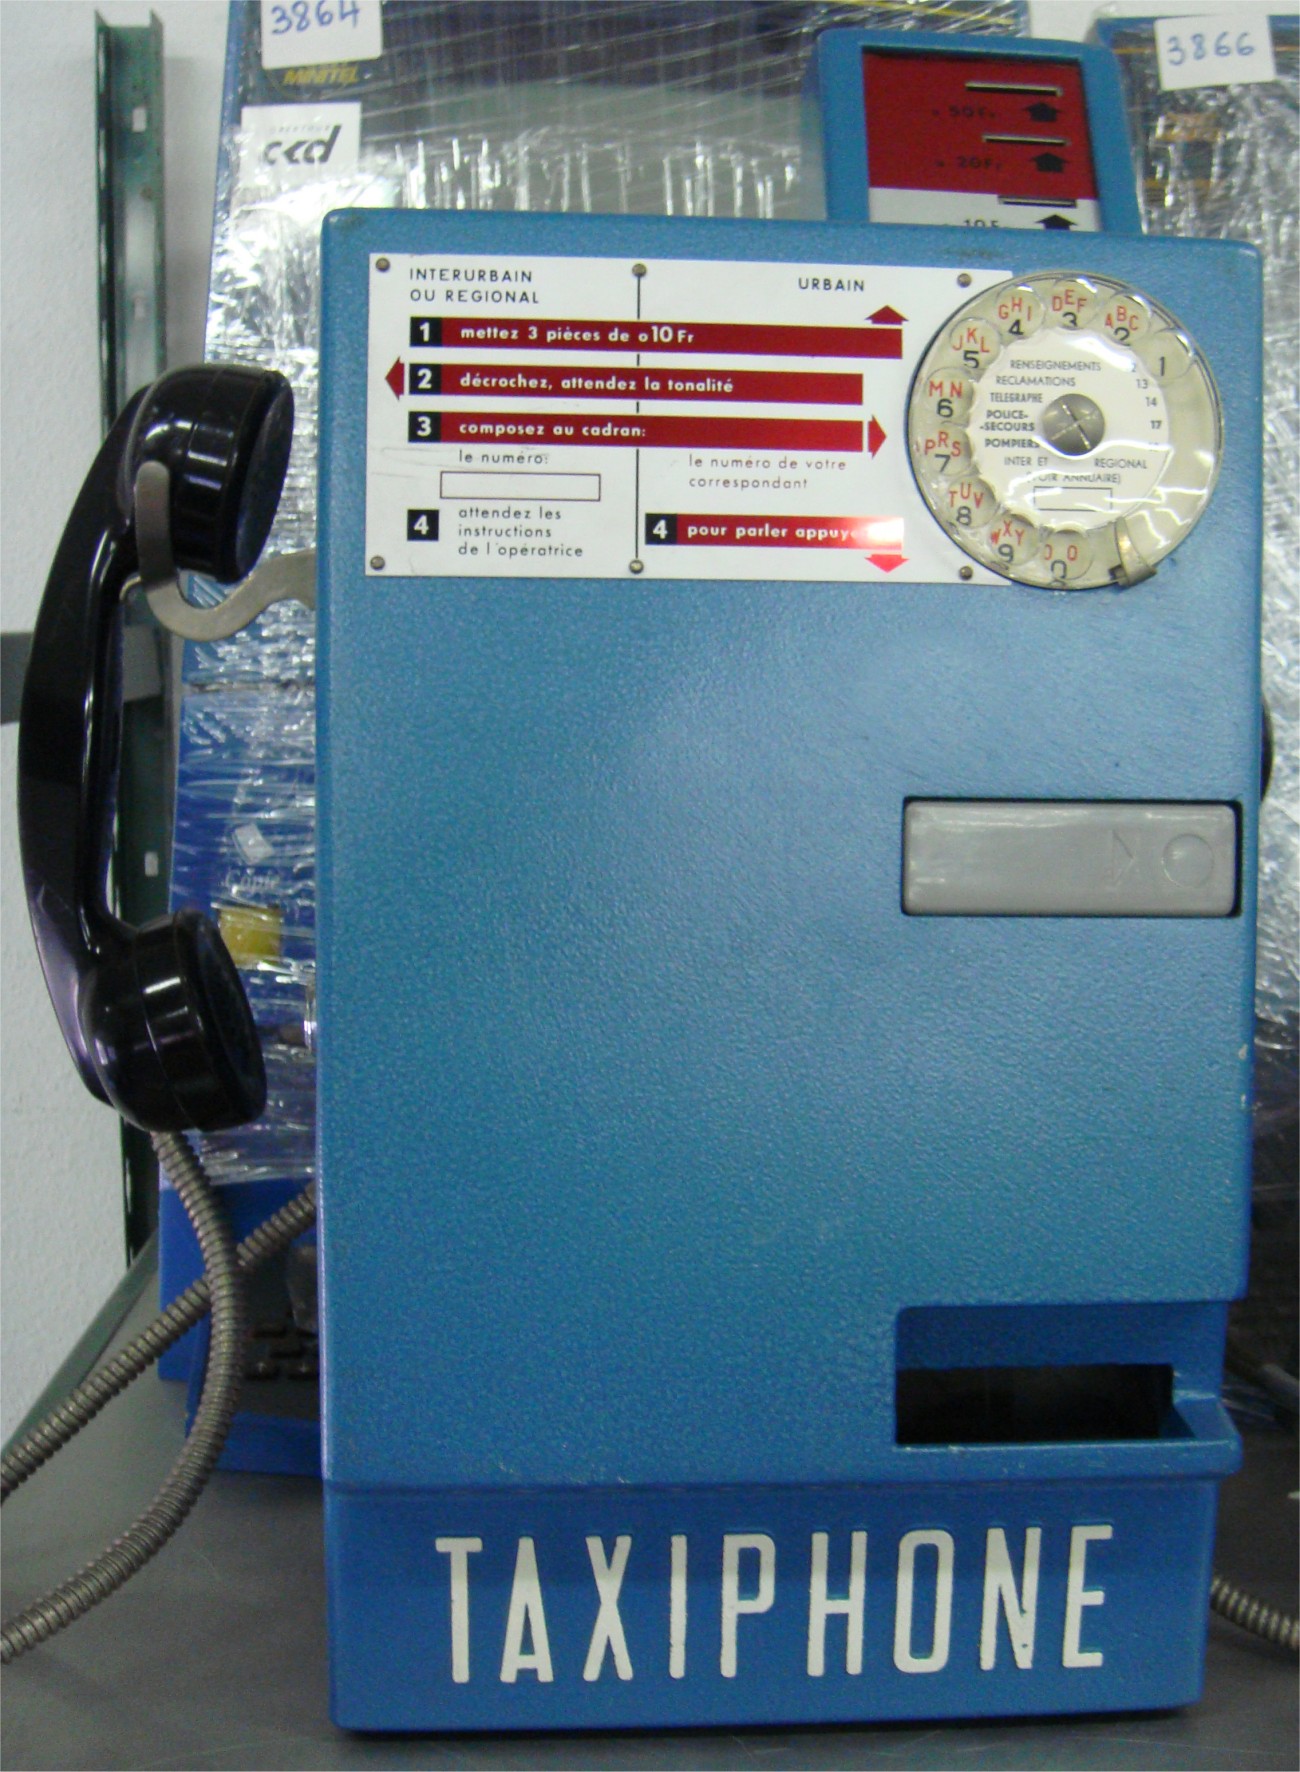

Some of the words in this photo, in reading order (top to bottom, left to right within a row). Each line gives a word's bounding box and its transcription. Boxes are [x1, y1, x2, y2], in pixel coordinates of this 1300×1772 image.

[270, 0, 360, 34] 3864
[1167, 32, 1255, 66] 3866
[409, 267, 533, 283] INTERURBAIN
[798, 277, 865, 292] URBAIN
[409, 288, 436, 302] OU
[445, 289, 540, 304] REGIONAL
[1007, 318, 1025, 337] 4
[1061, 311, 1078, 329] 3
[419, 321, 431, 342] 1
[460, 326, 520, 340] mettez
[527, 326, 539, 340] 3
[546, 326, 601, 343] pièces
[607, 327, 630, 342] de
[962, 350, 980, 370] 5
[1009, 359, 1102, 371] RENSEIGNEMENTS
[1157, 356, 1166, 377] 1
[417, 367, 433, 390] 2
[459, 372, 554, 391] décrochez,
[560, 376, 637, 391] attendez
[643, 376, 661, 391] la
[667, 377, 735, 393] tonalité
[995, 375, 1076, 387] RECLAMATIONS
[1136, 378, 1149, 390] 13
[936, 398, 954, 419] 6
[989, 392, 1043, 403] TELEGRAPHE
[1145, 396, 1158, 407] 14
[986, 409, 1029, 420] POLICE-
[416, 415, 432, 437] 3
[459, 421, 545, 437] composez
[552, 424, 575, 437] au
[581, 422, 647, 437] cadran:
[984, 438, 1041, 449] POMPIERS
[459, 449, 474, 464] le
[688, 454, 703, 468] le
[710, 455, 771, 470] numéro
[777, 456, 798, 470] de
[805, 458, 847, 472] votre
[934, 453, 951, 473] 7
[1004, 456, 1032, 467] INTER
[1037, 456, 1049, 467] ET
[1094, 457, 1148, 470] REGIONAL
[688, 475, 809, 491] correspondant
[413, 514, 430, 536] 4
[457, 505, 531, 520] attendez
[538, 505, 562, 520] les
[956, 505, 973, 527] 8
[457, 522, 553, 538] instructions
[652, 519, 669, 540] 4
[686, 524, 728, 540] pour
[735, 522, 788, 540] parler
[794, 527, 860, 542] appuy
[457, 541, 479, 556] de
[997, 543, 1015, 563] 9
[435, 1525, 1113, 1683] TAXIPHONE
